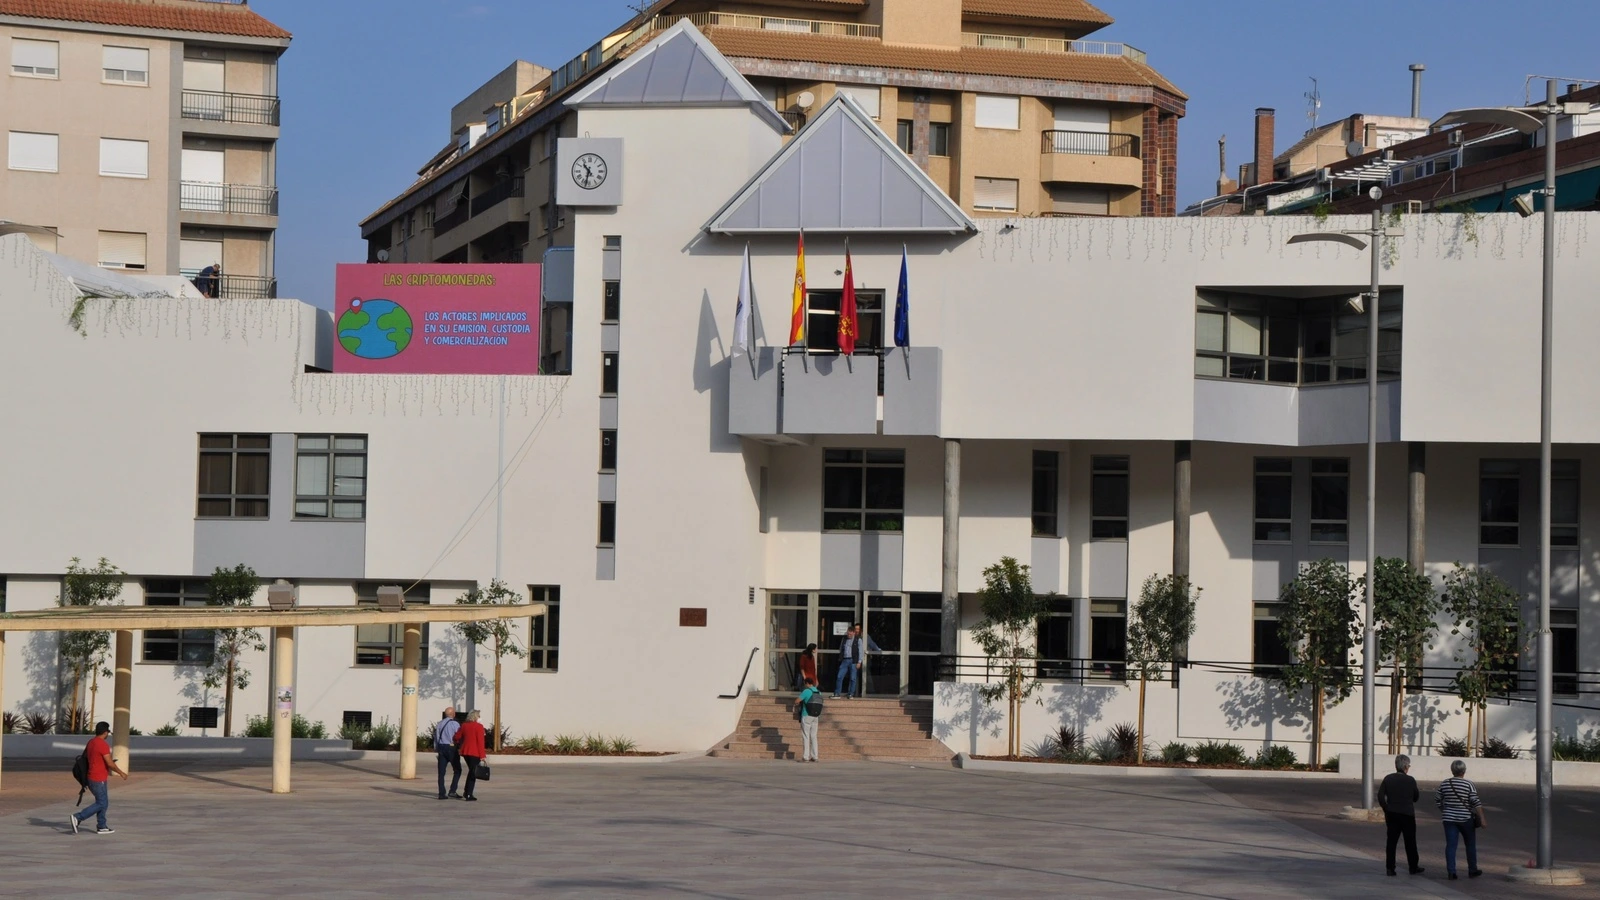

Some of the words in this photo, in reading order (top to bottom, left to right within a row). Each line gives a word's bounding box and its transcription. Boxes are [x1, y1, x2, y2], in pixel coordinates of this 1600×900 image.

[383, 273, 403, 286] LAS
[406, 273, 496, 286] CRIPTOMONEDAS:
[424, 312, 440, 321] LOS
[441, 312, 477, 321] ACTORES
[479, 312, 527, 321] IMPLICADOS
[424, 324, 437, 333] EN
[439, 324, 450, 333] SU
[491, 324, 531, 333] CUSTODIA
[424, 336, 430, 345] Y
[432, 333, 508, 345] COMERCIALIZACIÓN
